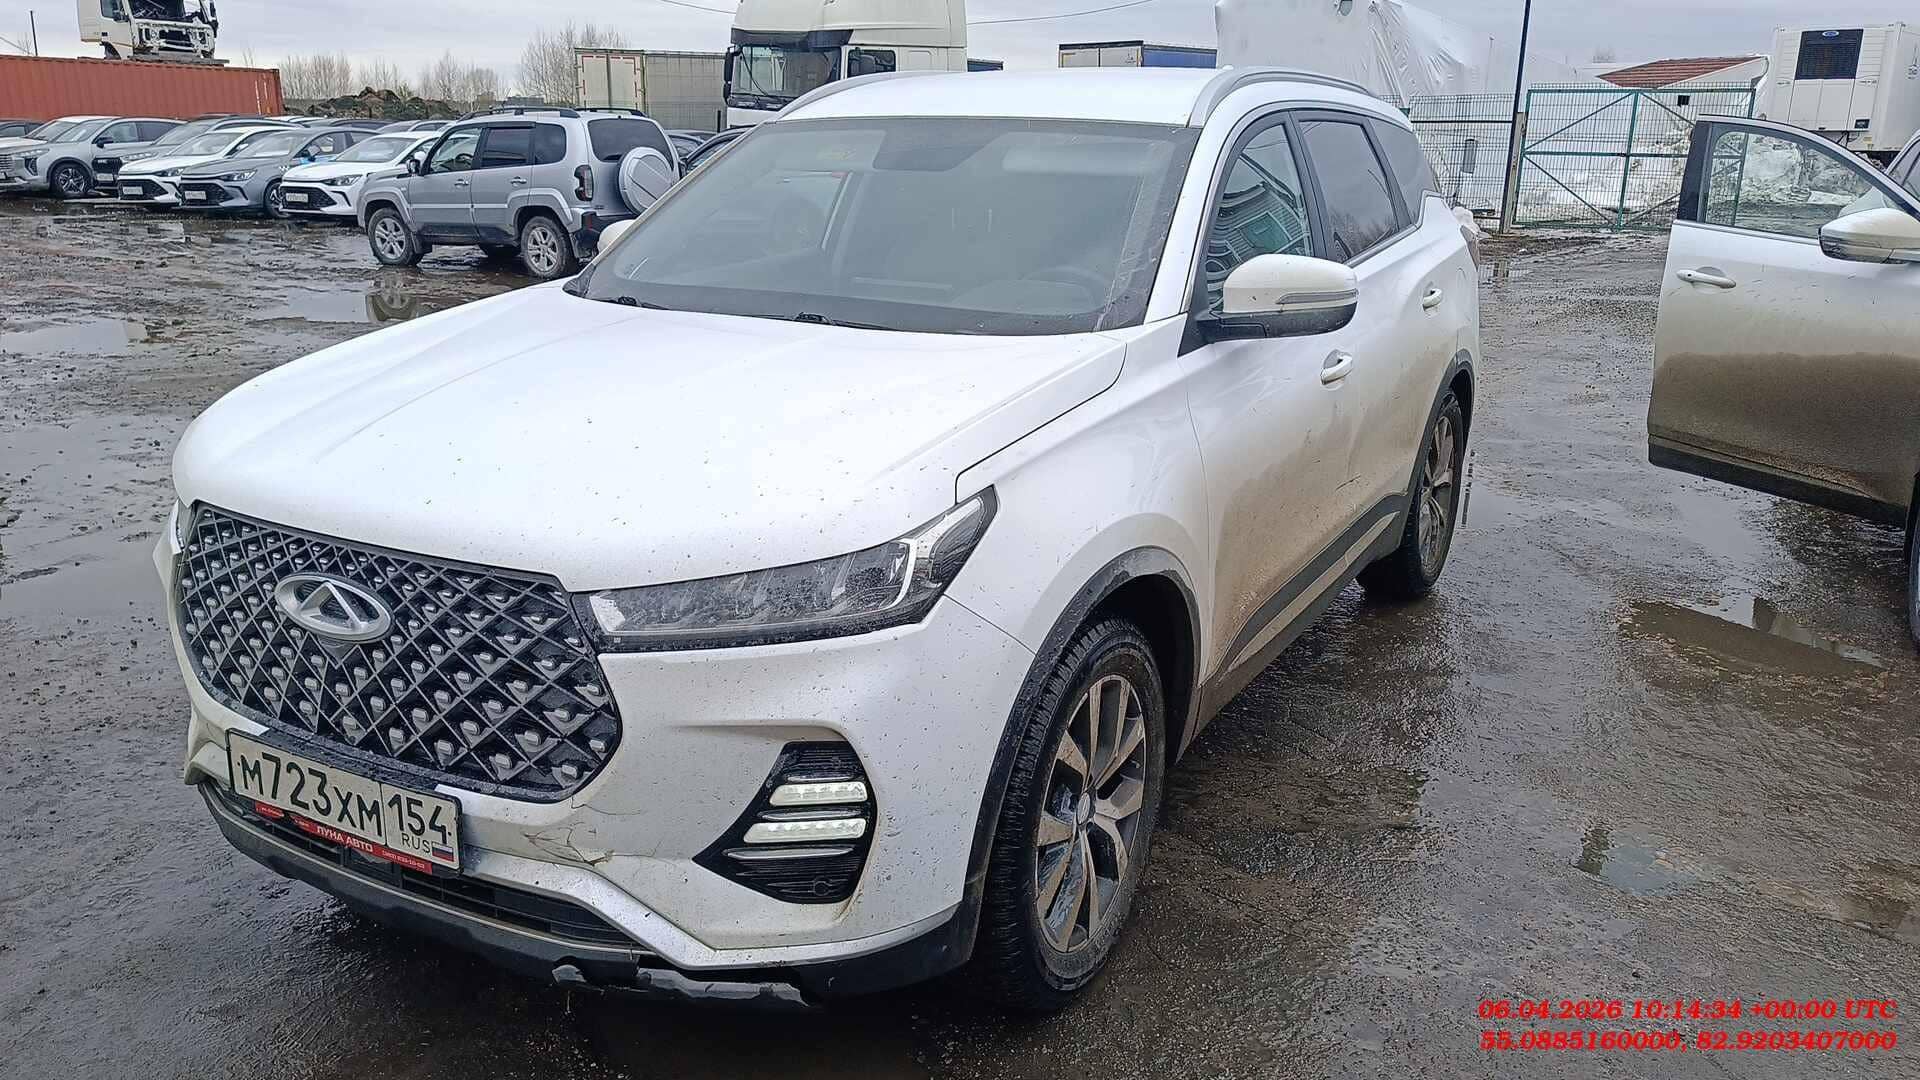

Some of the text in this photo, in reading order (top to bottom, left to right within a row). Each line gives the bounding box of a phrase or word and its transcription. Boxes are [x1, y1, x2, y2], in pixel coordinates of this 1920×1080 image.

[240, 751, 449, 845] М723ХМ 154
[345, 836, 374, 853] АВТО
[401, 833, 431, 854] RUS
